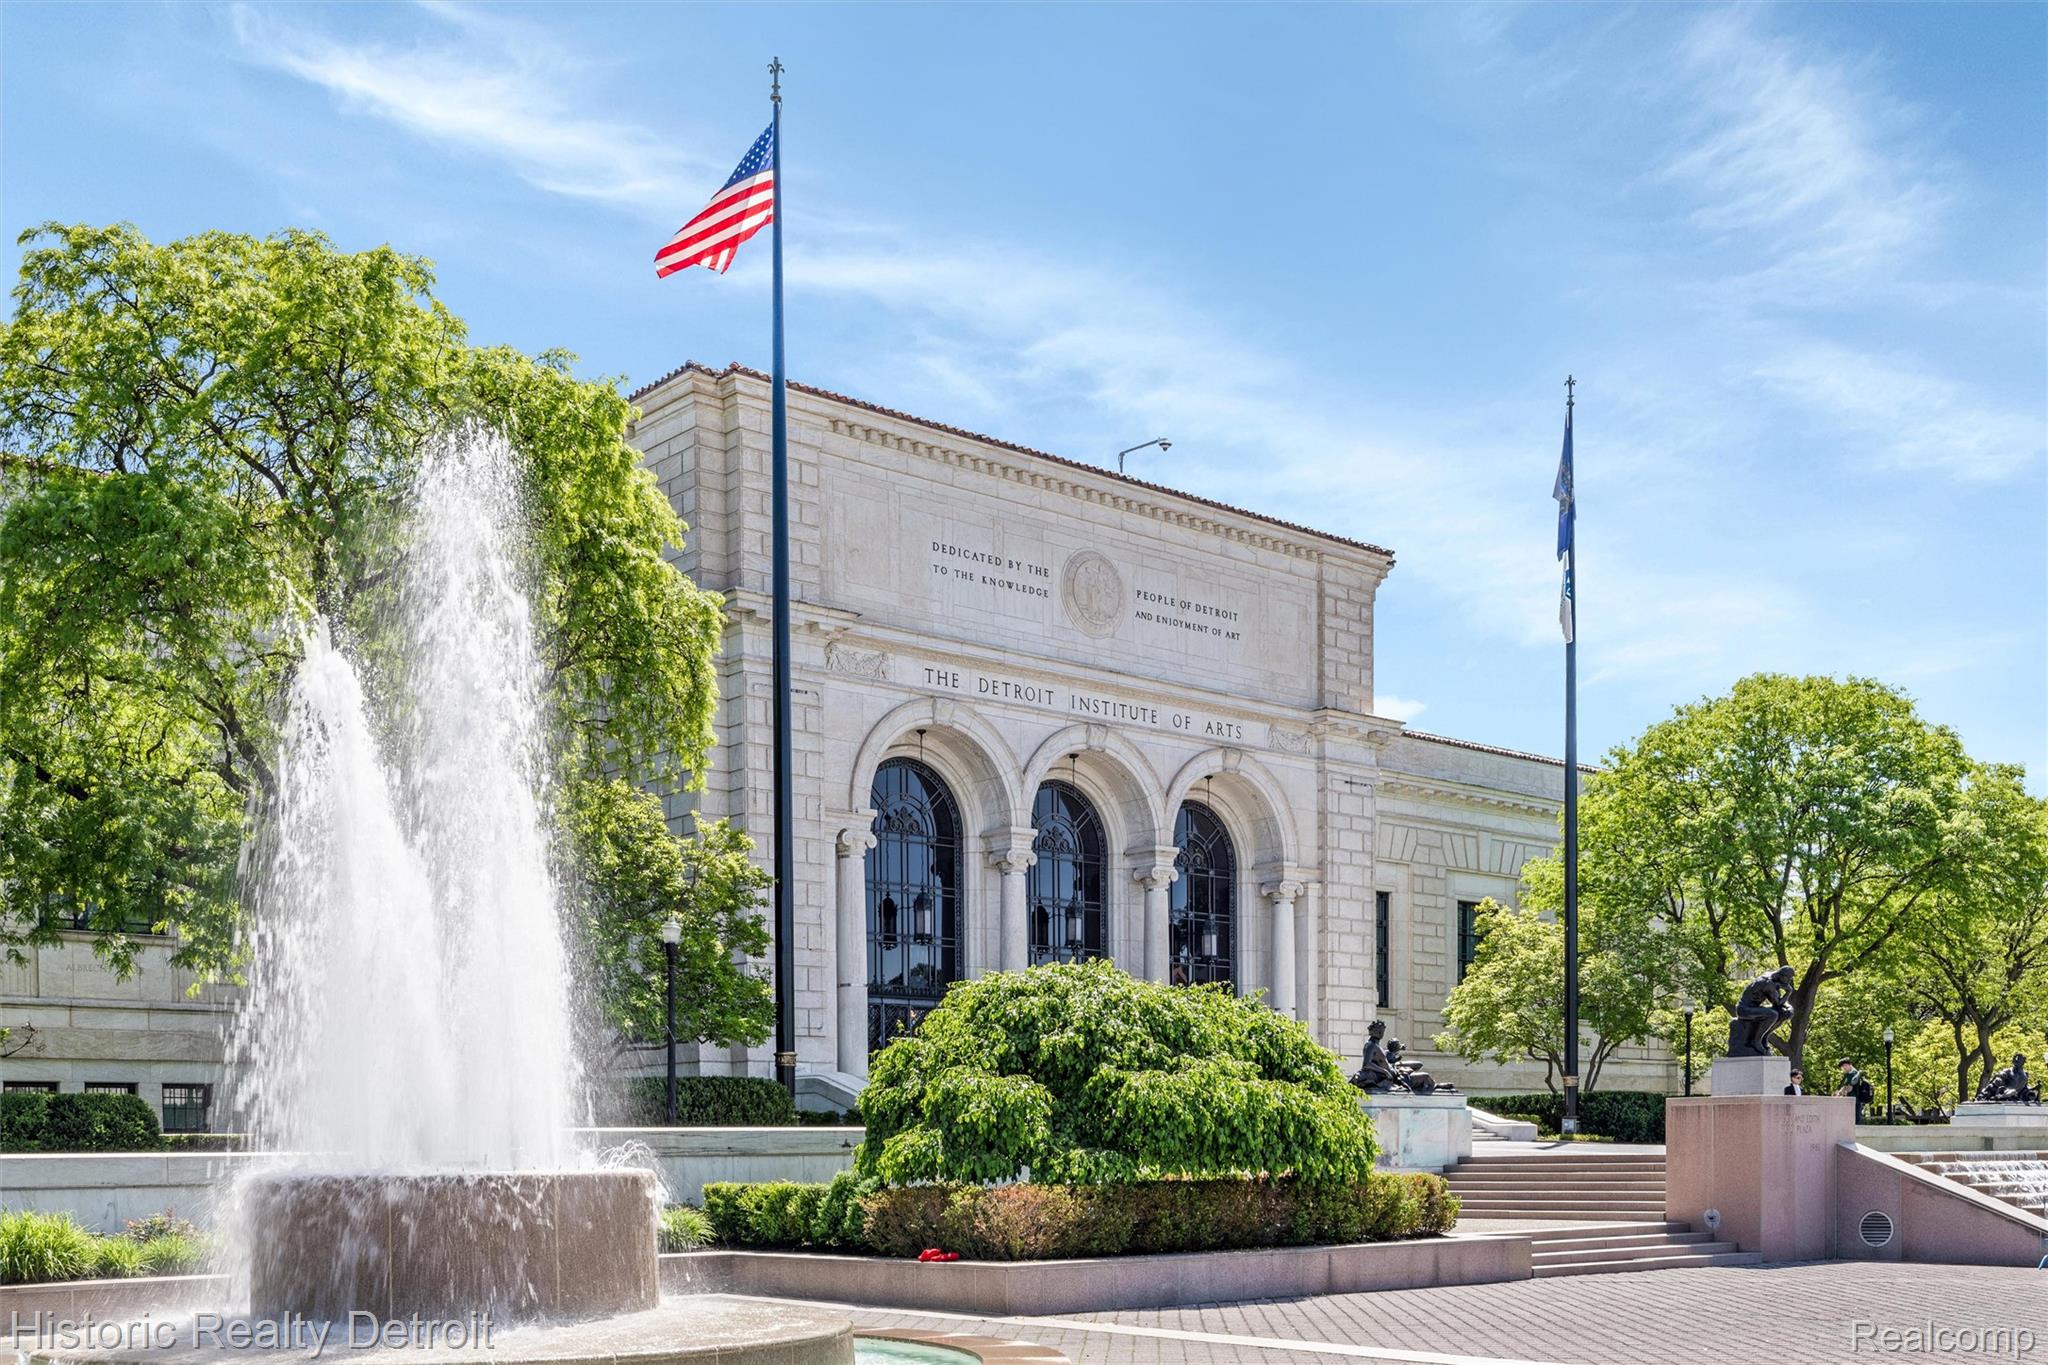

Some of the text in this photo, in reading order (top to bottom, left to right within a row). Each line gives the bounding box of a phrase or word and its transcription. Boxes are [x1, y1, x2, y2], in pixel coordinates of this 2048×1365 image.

[932, 541, 1049, 578] DEDICATED BY THE
[932, 563, 1049, 598] TO THE KNOWLEDGE
[1136, 589, 1238, 622] PEOPLE OF DETROIT
[1135, 610, 1241, 641] AND ENJOYMENT OF ART
[925, 667, 1242, 739] THE DETROIT INSTITUTE OF ARTS
